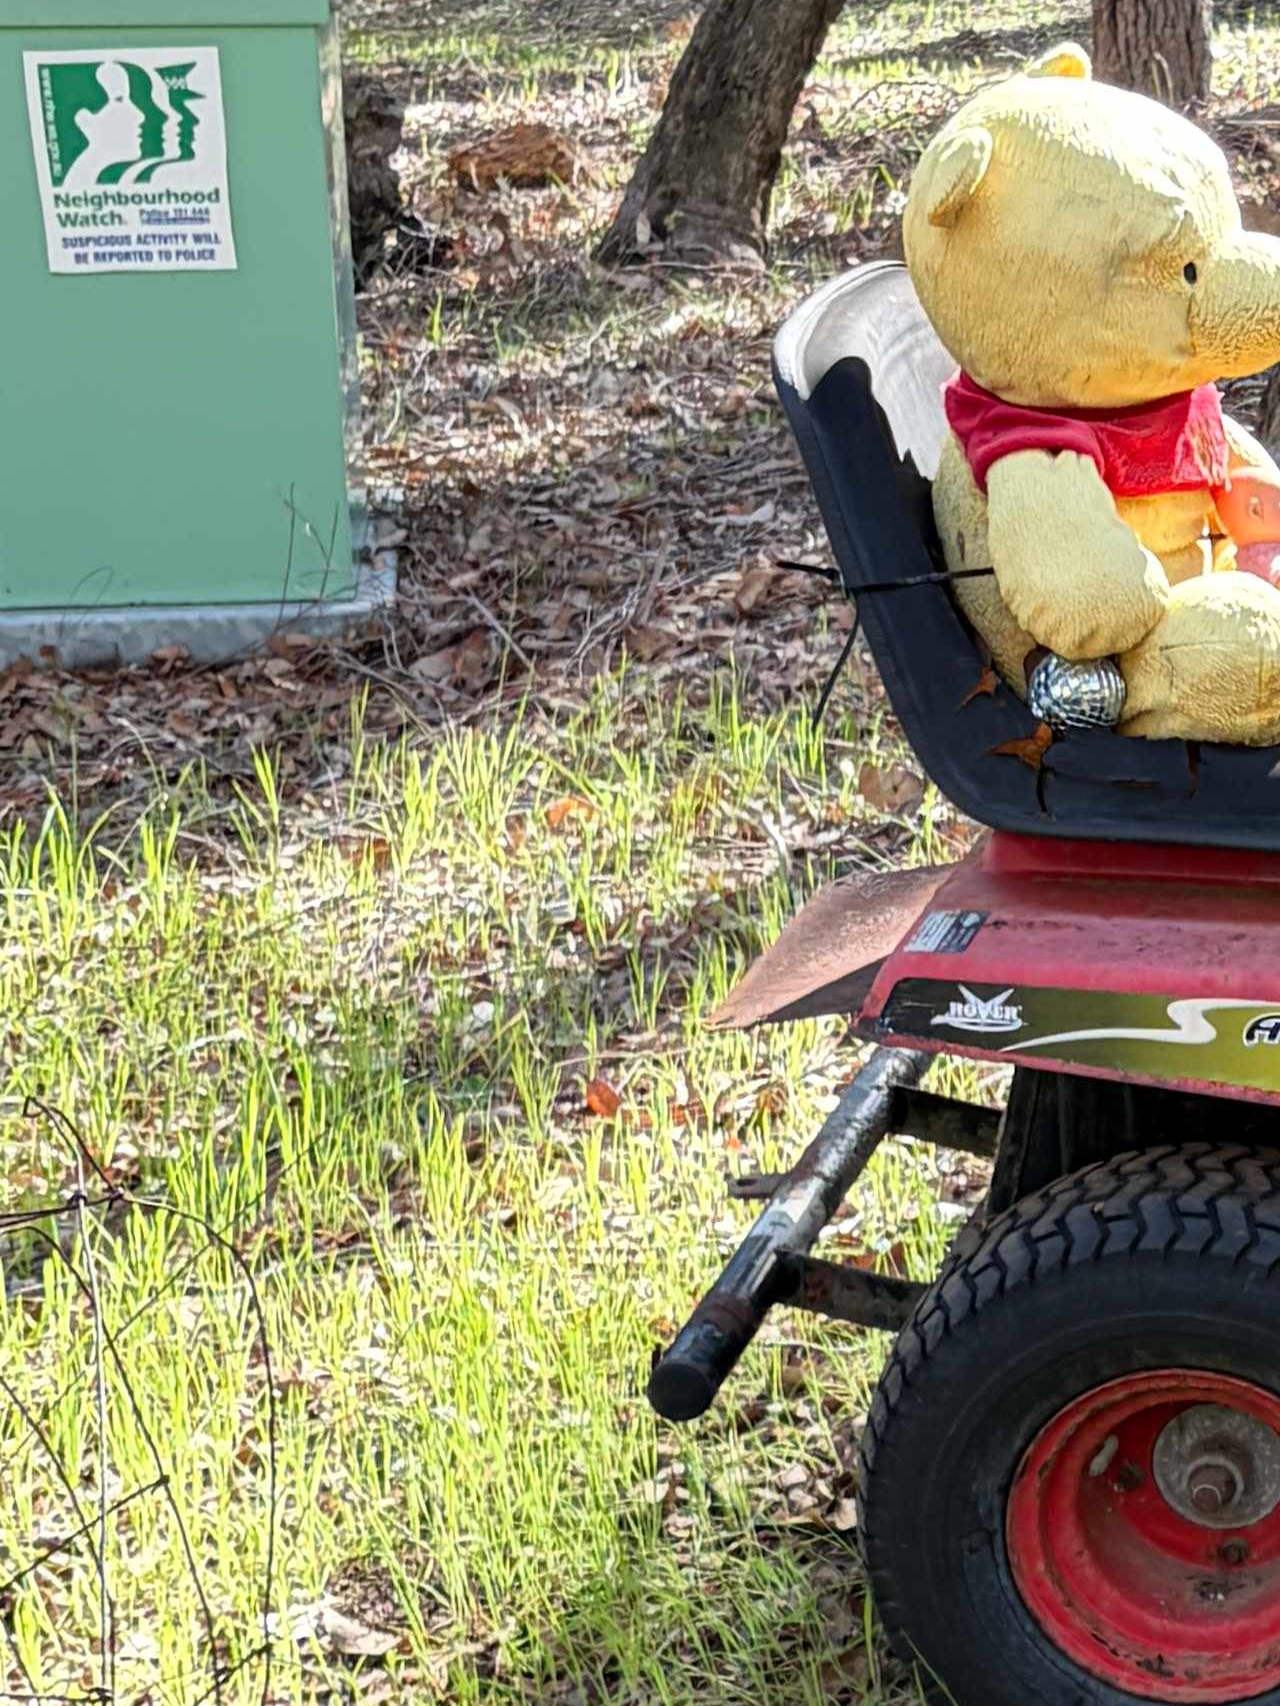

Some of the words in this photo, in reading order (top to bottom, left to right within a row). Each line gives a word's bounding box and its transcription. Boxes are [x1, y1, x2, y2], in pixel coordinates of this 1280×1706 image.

[54, 188, 220, 211] Neighbourhood
[56, 210, 123, 229] Watch
[61, 235, 132, 249] SUSPICIOUS
[136, 233, 188, 246] ACTIVITY
[192, 233, 221, 244] WILL
[74, 252, 89, 265] BE
[93, 250, 154, 263] REPORTED
[157, 250, 172, 262] TO
[175, 249, 216, 261] POLICE
[949, 1001, 1020, 1022] ROVER
